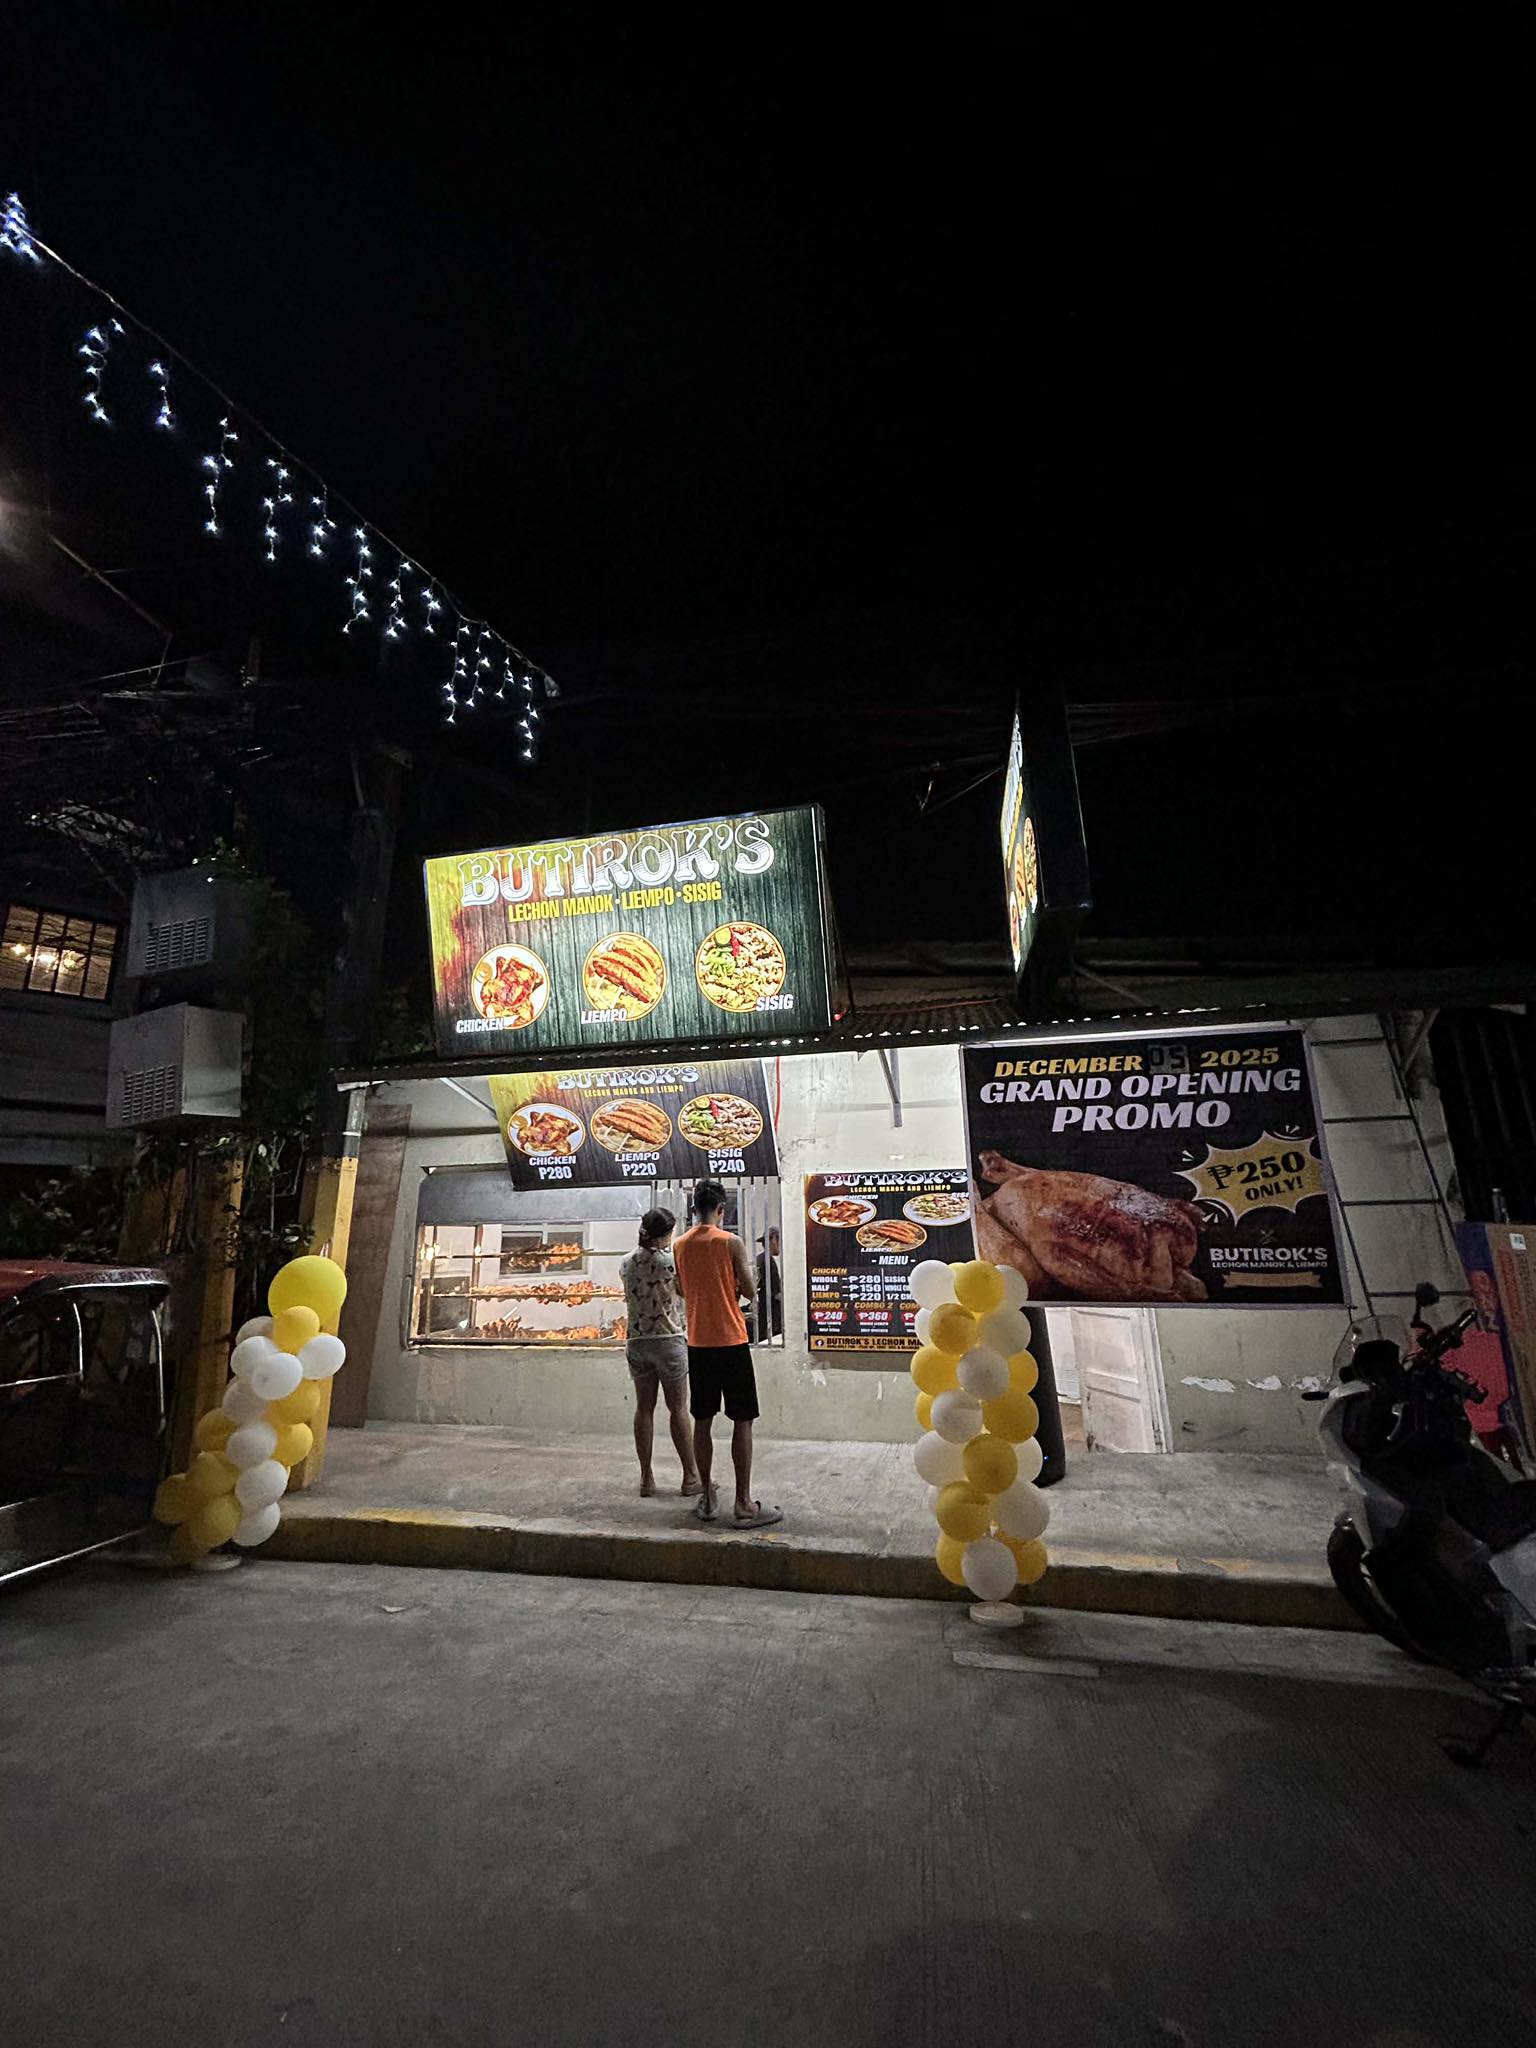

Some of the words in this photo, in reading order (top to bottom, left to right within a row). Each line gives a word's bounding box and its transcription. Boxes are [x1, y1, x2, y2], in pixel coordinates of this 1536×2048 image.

[458, 818, 775, 907] BUTIROK'S
[508, 901, 559, 922] LECHON
[563, 894, 613, 916] MANOK
[622, 886, 674, 909] LIEMPO
[683, 881, 721, 903] SISIG
[756, 994, 794, 1011] SISIG
[456, 1016, 504, 1033] CHICKEN
[581, 1008, 627, 1025] LIEMPO
[995, 1054, 1143, 1078] DECEMBER
[1201, 1047, 1280, 1068] 2025
[557, 1065, 699, 1089] BUTIROK'S
[640, 1086, 654, 1094] AND
[657, 1084, 684, 1093] LIEMPO
[979, 1077, 1112, 1104] GRAND
[1120, 1068, 1301, 1099] OPENING
[1051, 1100, 1231, 1133] PROMO
[528, 1154, 577, 1166] CHICKEN
[614, 1151, 660, 1162] LIEMPO
[708, 1148, 743, 1159] SISIG
[538, 1166, 573, 1180] P280
[622, 1162, 657, 1177] P220
[709, 1159, 745, 1174] P240
[824, 1170, 969, 1187] BUTIROK'S
[1245, 1175, 1304, 1201] ONLY!
[879, 1255, 909, 1265] MENU
[1209, 1247, 1328, 1261] BUTIROK'S
